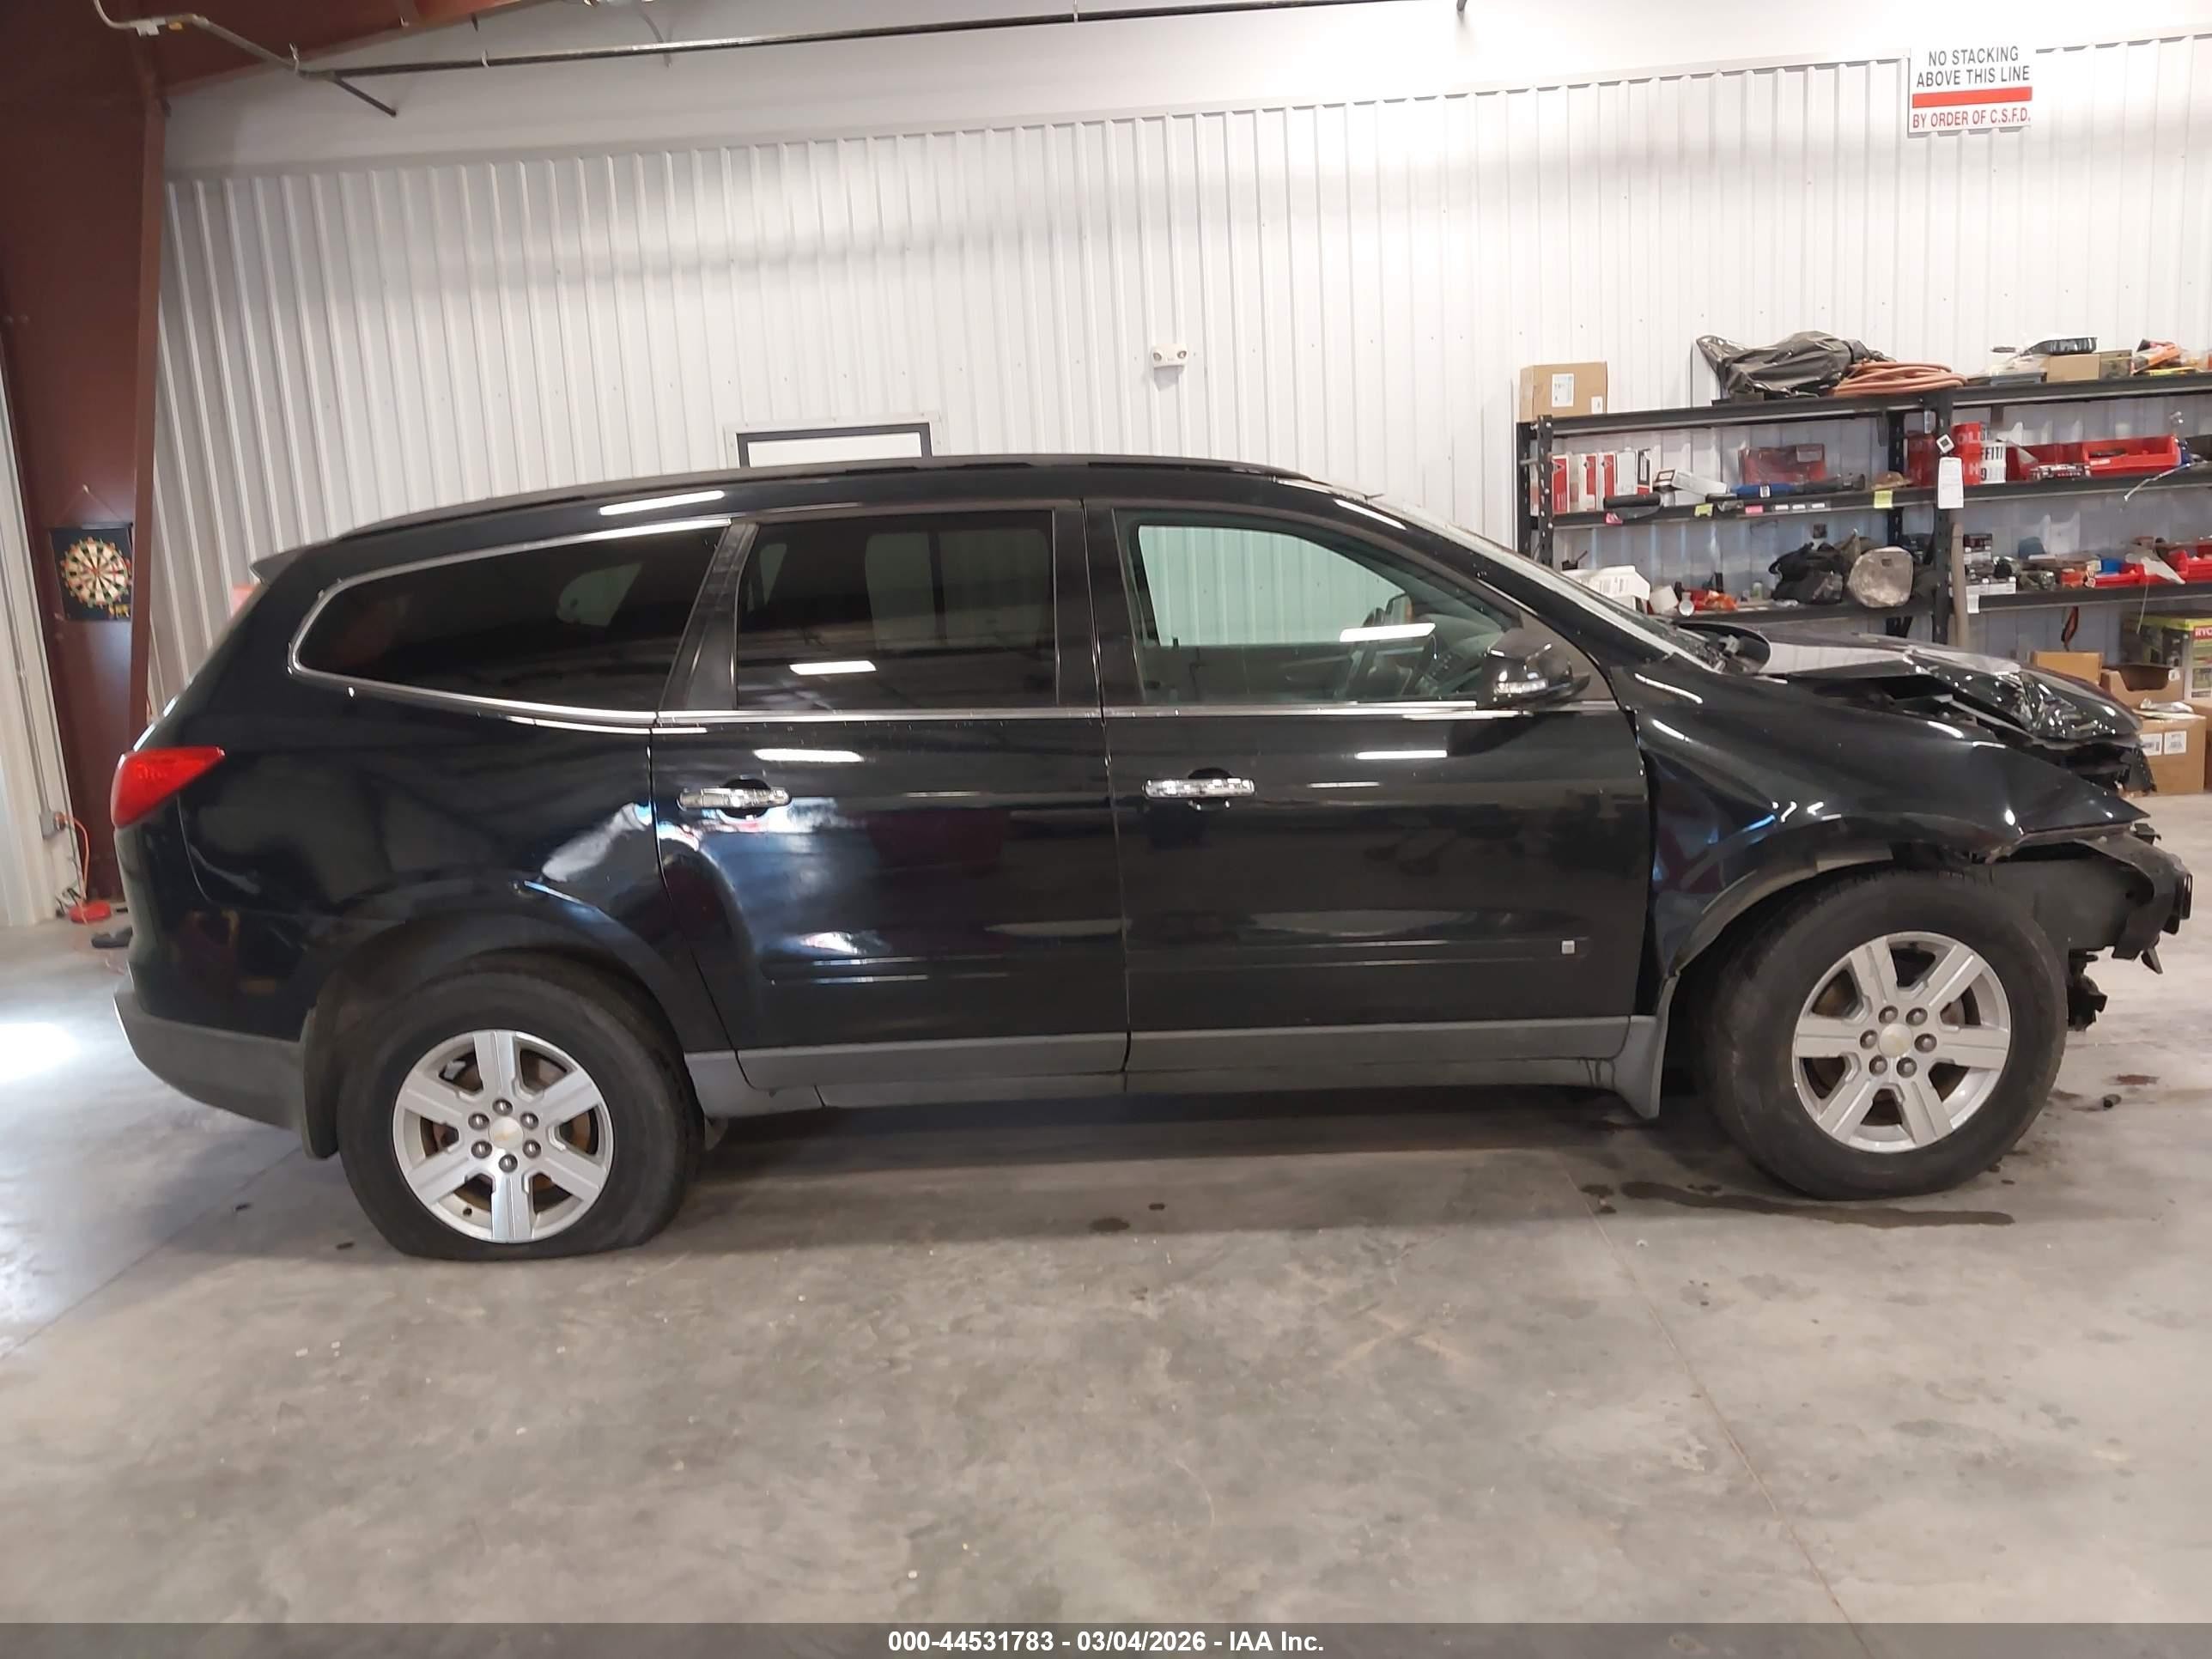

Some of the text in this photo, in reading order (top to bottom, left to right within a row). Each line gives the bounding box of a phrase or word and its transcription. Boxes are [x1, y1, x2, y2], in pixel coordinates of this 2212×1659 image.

[1929, 46, 2019, 66] NO STACKING
[1917, 65, 2030, 88] ABOVE THIS LINE
[1912, 106, 2032, 129] BY ORDER OF C.S.F.D.
